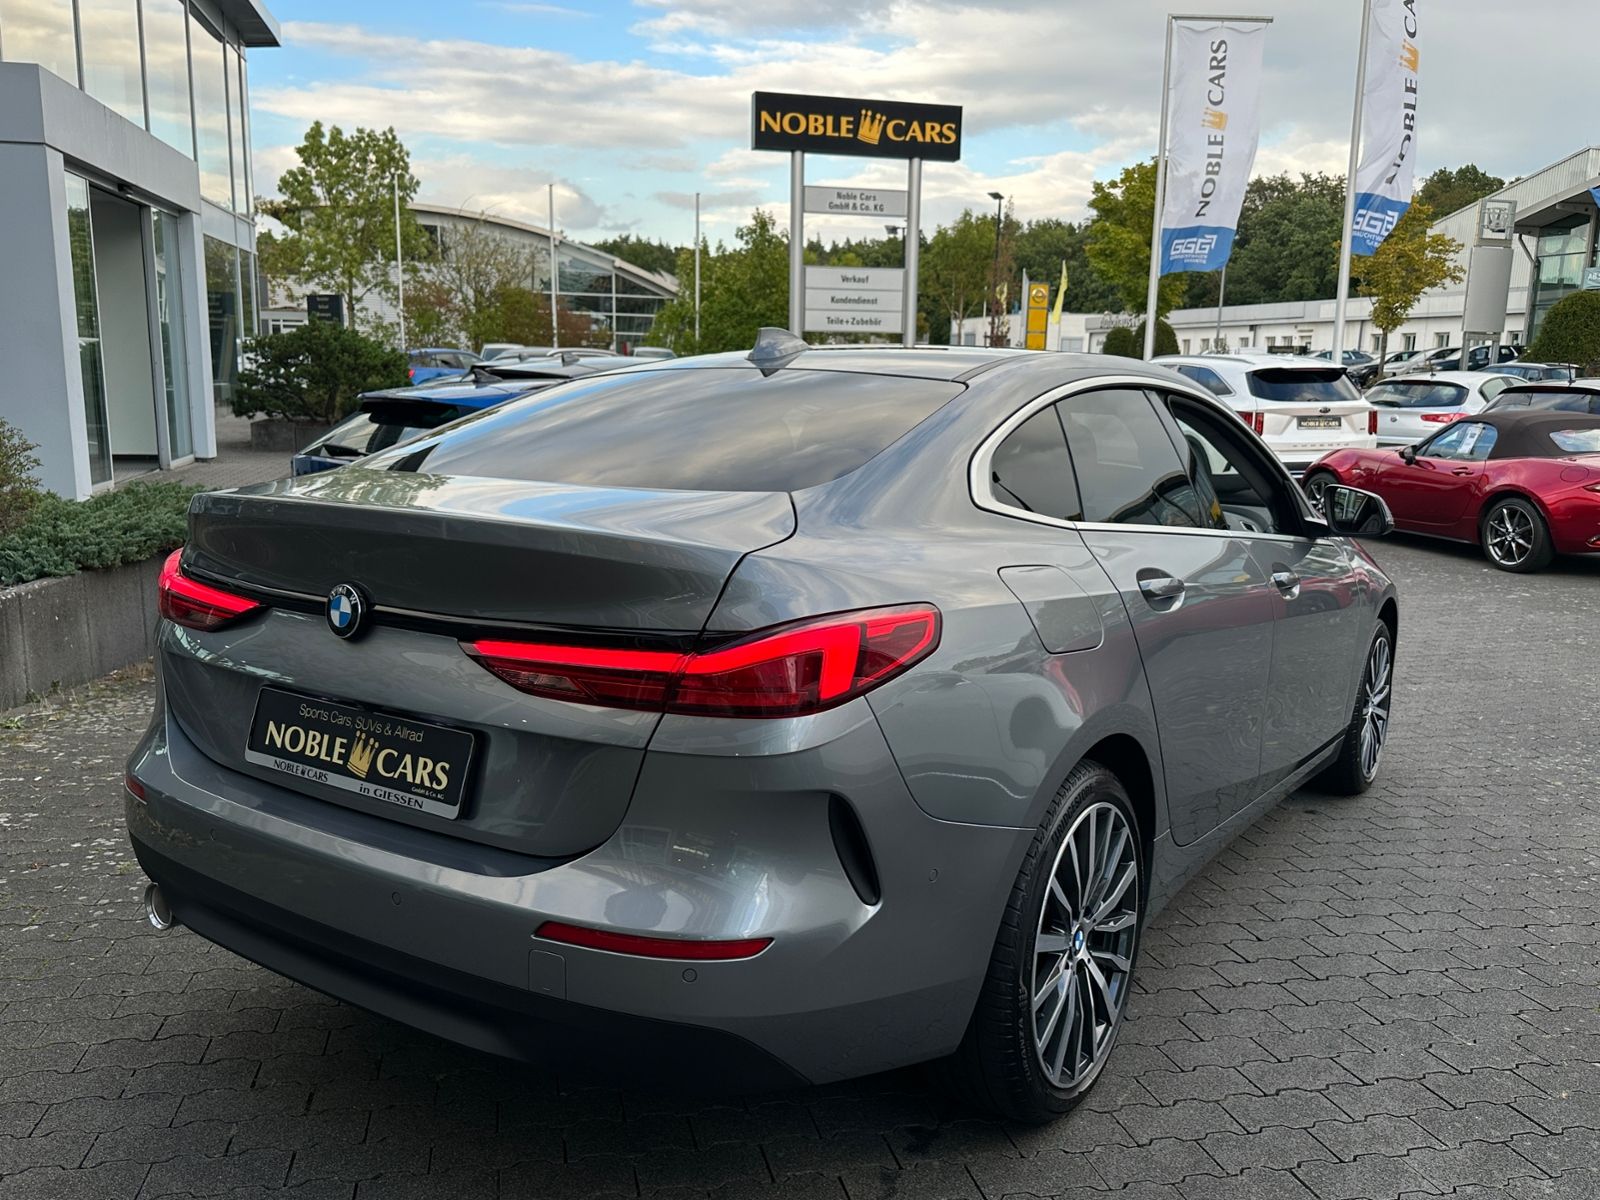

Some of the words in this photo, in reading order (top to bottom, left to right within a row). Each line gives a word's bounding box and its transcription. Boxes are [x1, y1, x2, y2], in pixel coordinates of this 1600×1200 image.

[1207, 39, 1228, 106] CARS
[760, 111, 853, 137] NOBLE
[886, 120, 956, 144] CARS
[1195, 134, 1224, 217] NOBLE
[828, 201, 850, 210] GmbH
[852, 202, 858, 211] &
[859, 202, 873, 212] Co.
[873, 203, 885, 213] KG
[836, 191, 857, 201] Noble
[859, 192, 877, 202] Cars
[840, 274, 870, 284] Verkauf
[830, 295, 878, 305] Kundendienst
[299, 703, 329, 721] Sports
[330, 710, 353, 729] Cars,
[355, 715, 383, 734] SUVs
[383, 722, 392, 736] &
[393, 724, 425, 743] Allrad
[265, 720, 348, 765] NOBLE
[376, 748, 450, 791] CARS
[273, 759, 301, 775] NOBLE
[306, 768, 329, 783] CARS
[359, 783, 370, 795] in
[373, 788, 424, 809] GIESSEN
